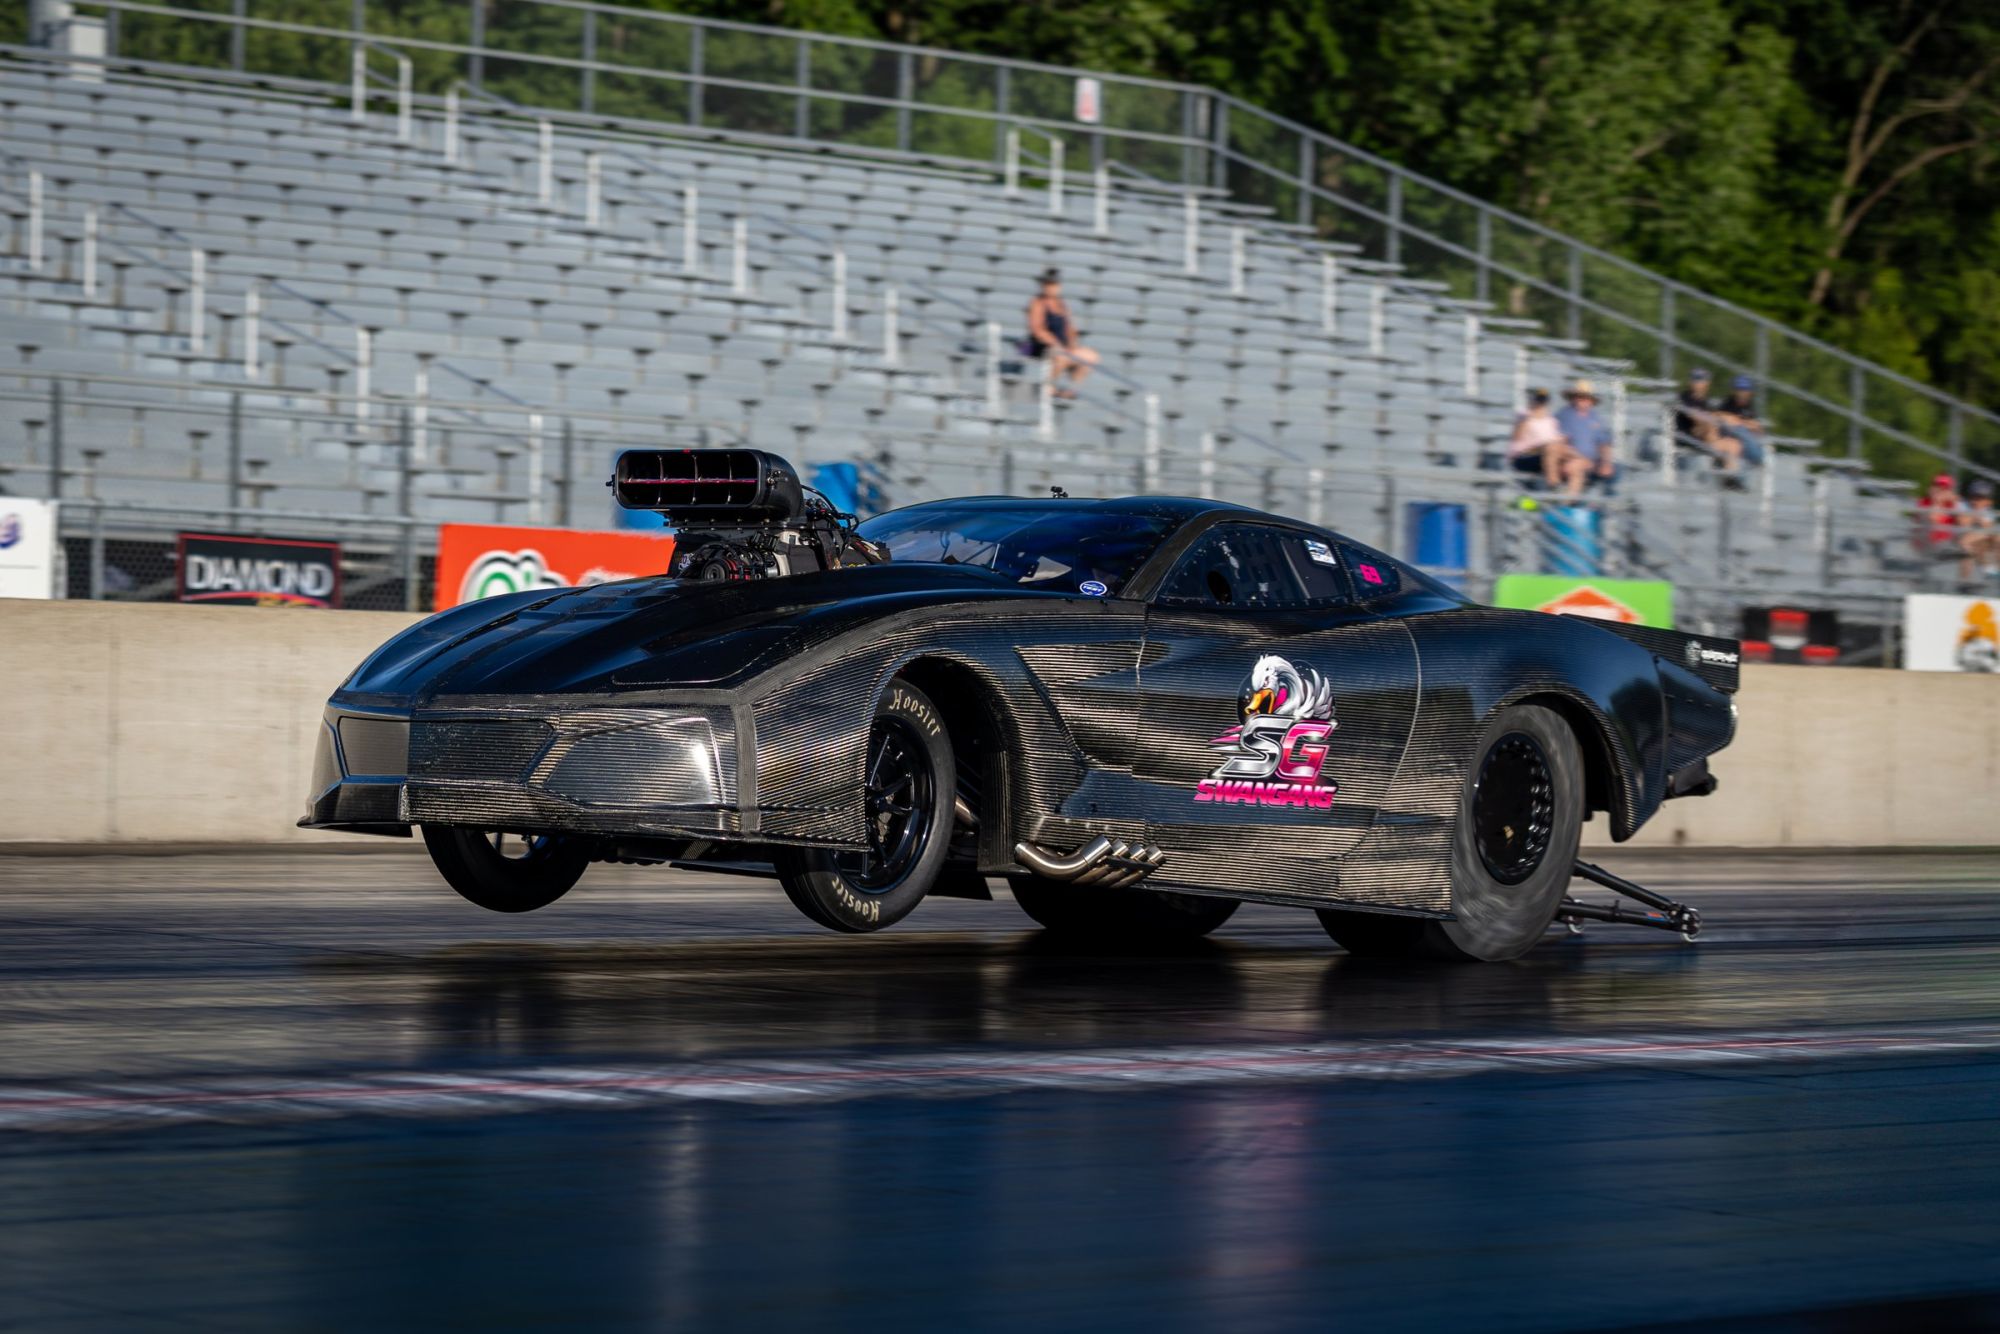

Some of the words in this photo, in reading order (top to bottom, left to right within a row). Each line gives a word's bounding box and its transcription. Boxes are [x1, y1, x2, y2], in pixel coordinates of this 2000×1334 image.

[185, 554, 335, 597] DIAMOND
[888, 688, 941, 736] Hoosier
[1211, 713, 1338, 782] SG
[1194, 778, 1338, 811] SWANGANG
[831, 876, 882, 922] Hoosier
